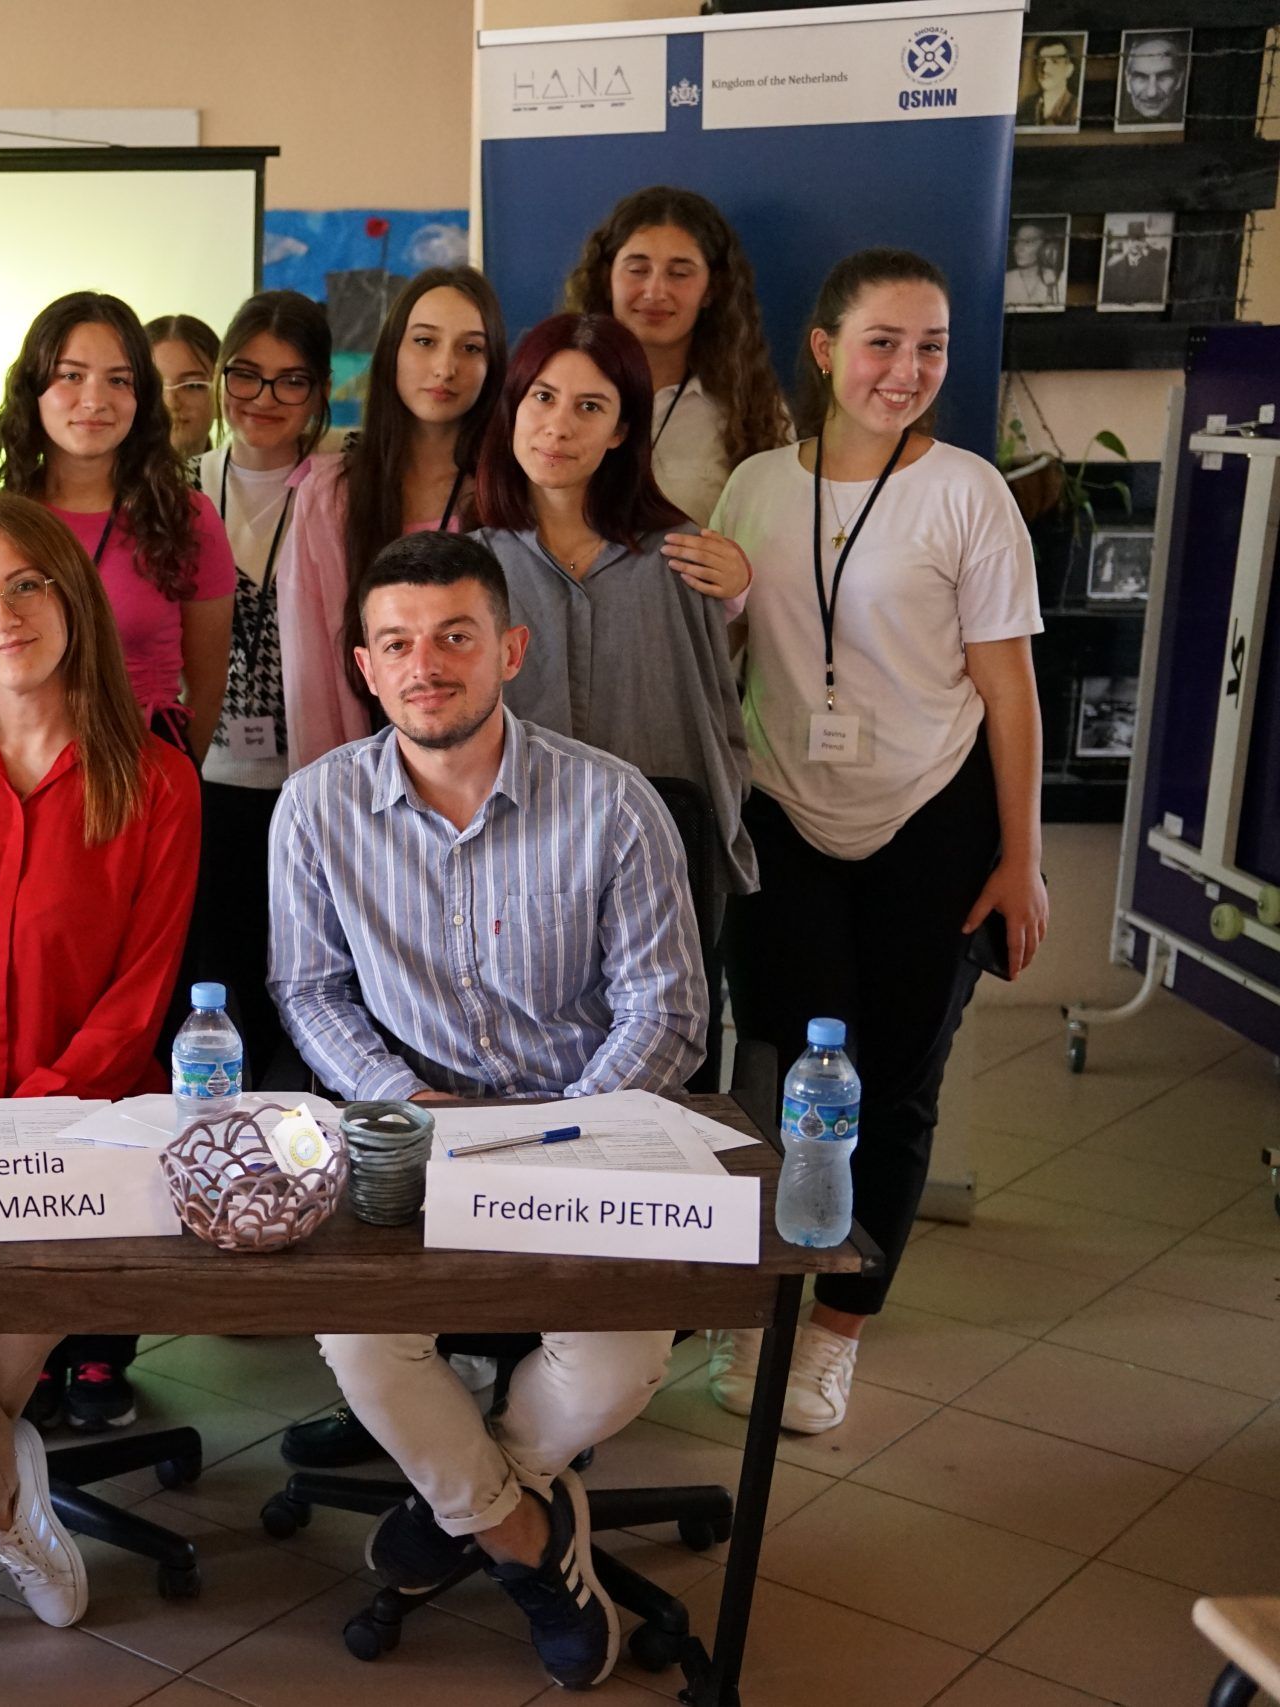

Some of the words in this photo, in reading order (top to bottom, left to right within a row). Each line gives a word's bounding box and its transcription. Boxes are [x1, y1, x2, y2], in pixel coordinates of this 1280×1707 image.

[711, 77, 755, 91] Kingdom
[757, 75, 769, 87] of
[770, 75, 786, 86] the
[788, 72, 849, 85] Netherlands
[898, 88, 958, 110] QSNNN
[473, 1194, 589, 1223] Frederik
[600, 1200, 713, 1229] PJETRAJ
